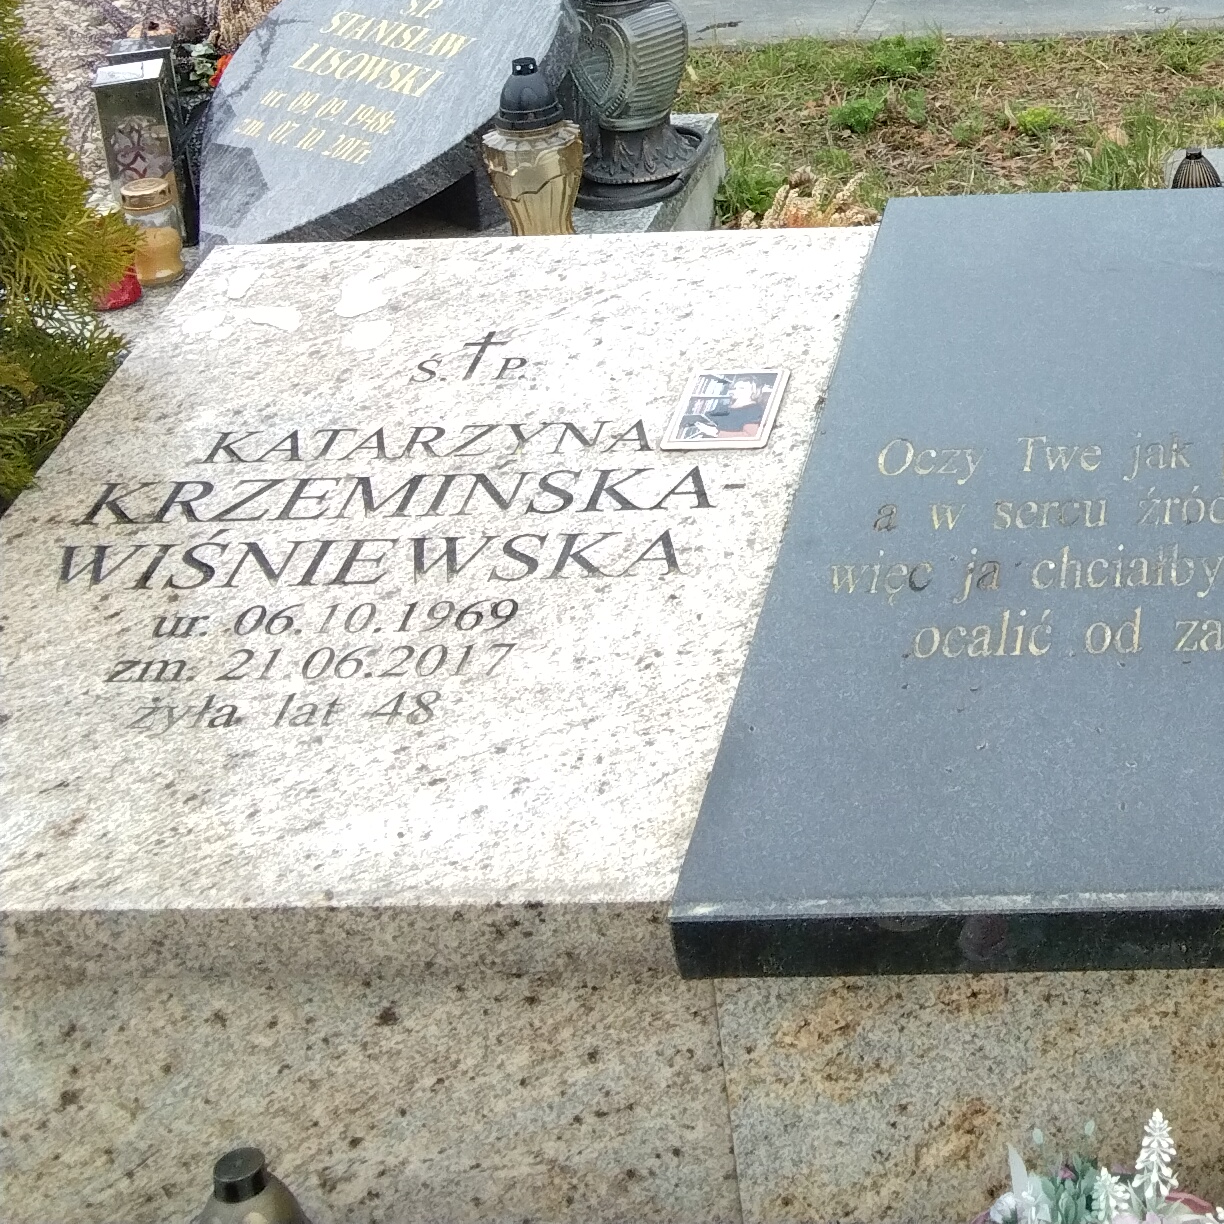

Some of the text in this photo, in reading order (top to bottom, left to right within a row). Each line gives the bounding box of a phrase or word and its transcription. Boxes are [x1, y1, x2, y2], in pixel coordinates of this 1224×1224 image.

[319, 10, 478, 60] STANISŁAW
[289, 42, 446, 98] LISOWSKI
[200, 418, 655, 464] KATARZYNA
[877, 437, 985, 486] Oczy
[1017, 435, 1103, 473] Twe
[1123, 432, 1192, 481] jak
[873, 503, 899, 534] a
[930, 501, 967, 532] w
[993, 497, 1108, 532] sercu
[56, 528, 689, 593] WIŚNIEWSKA
[830, 549, 934, 608] więc
[952, 548, 1002, 605] ja
[151, 598, 519, 639] ur. 06.10.1969
[913, 608, 1053, 660] ocalić
[1085, 605, 1143, 656] od
[104, 643, 519, 683] zm. 21.06.2017
[125, 690, 443, 738] żyła lat 48
